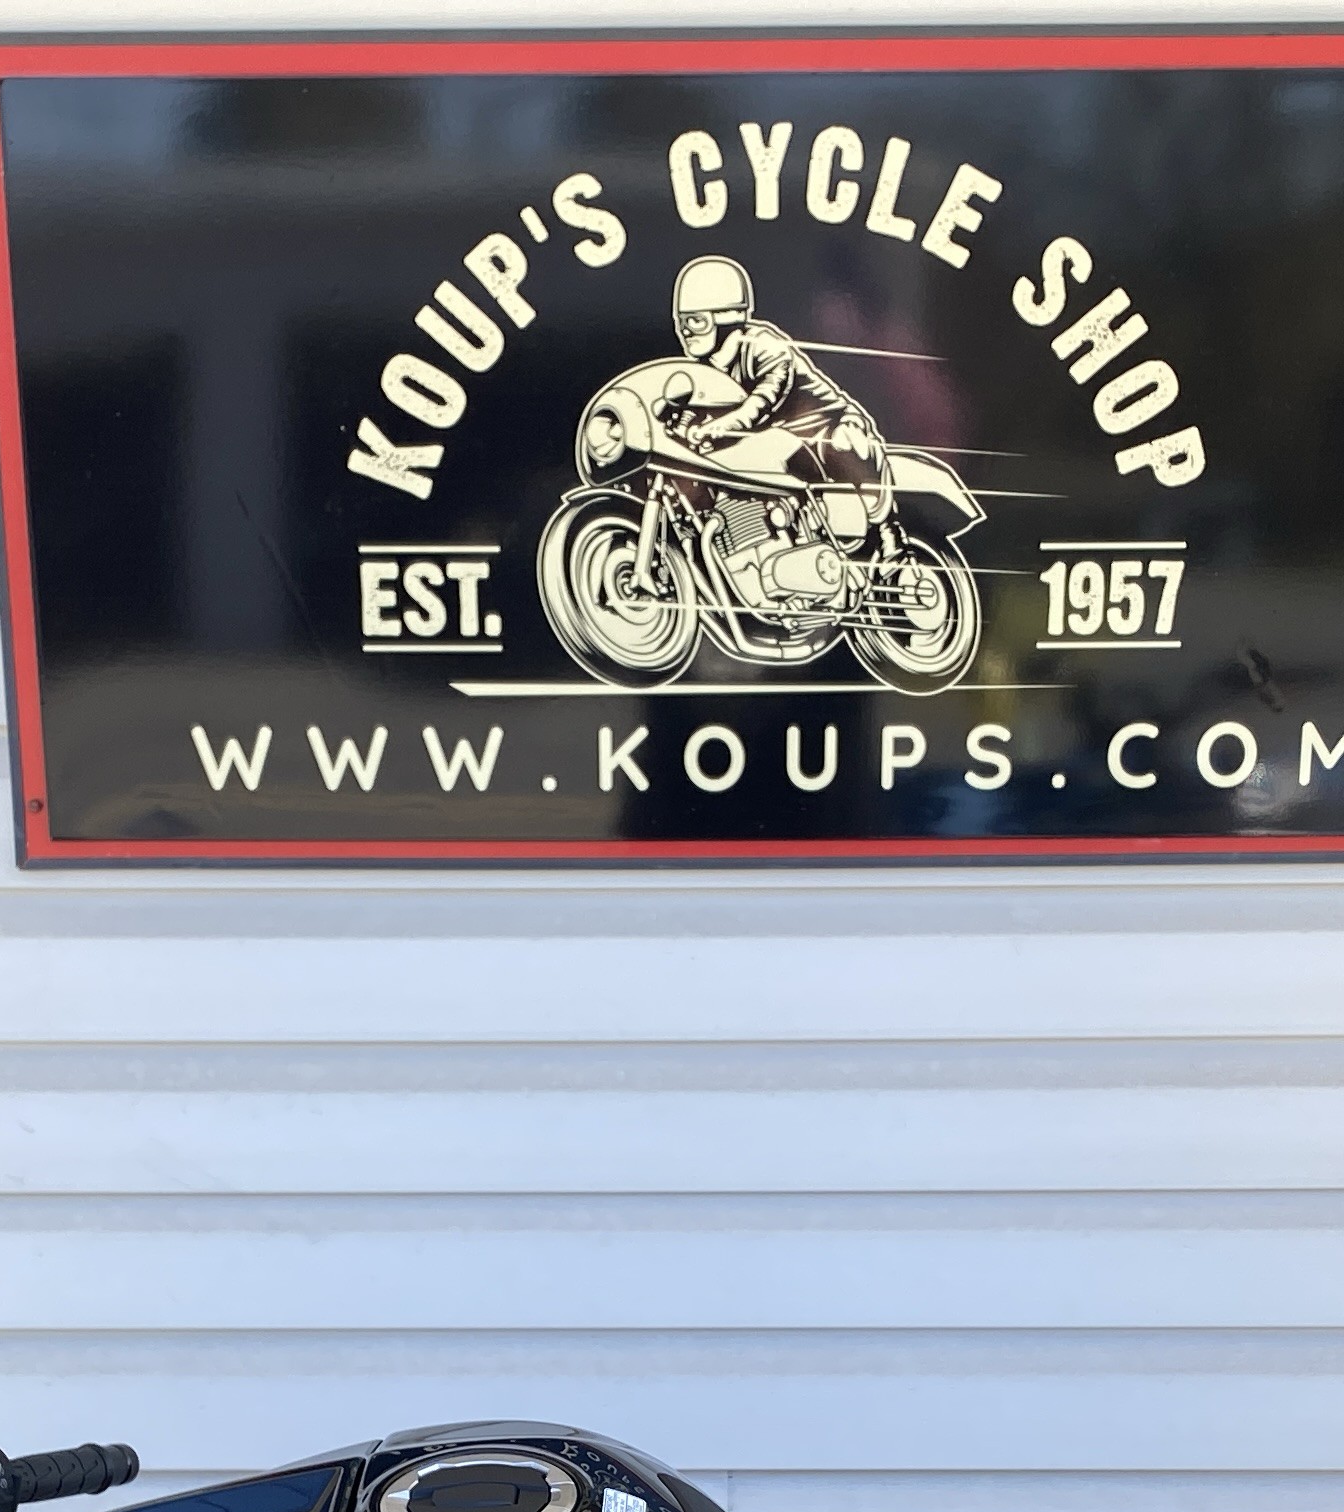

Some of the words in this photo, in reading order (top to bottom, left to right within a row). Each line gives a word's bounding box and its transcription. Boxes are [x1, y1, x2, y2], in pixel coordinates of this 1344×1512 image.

[346, 172, 627, 501] KOUP'S
[668, 121, 1003, 269] CYCLE
[1011, 236, 1207, 488] SHOP
[358, 561, 503, 637] EST.
[1039, 560, 1186, 636] 1957
